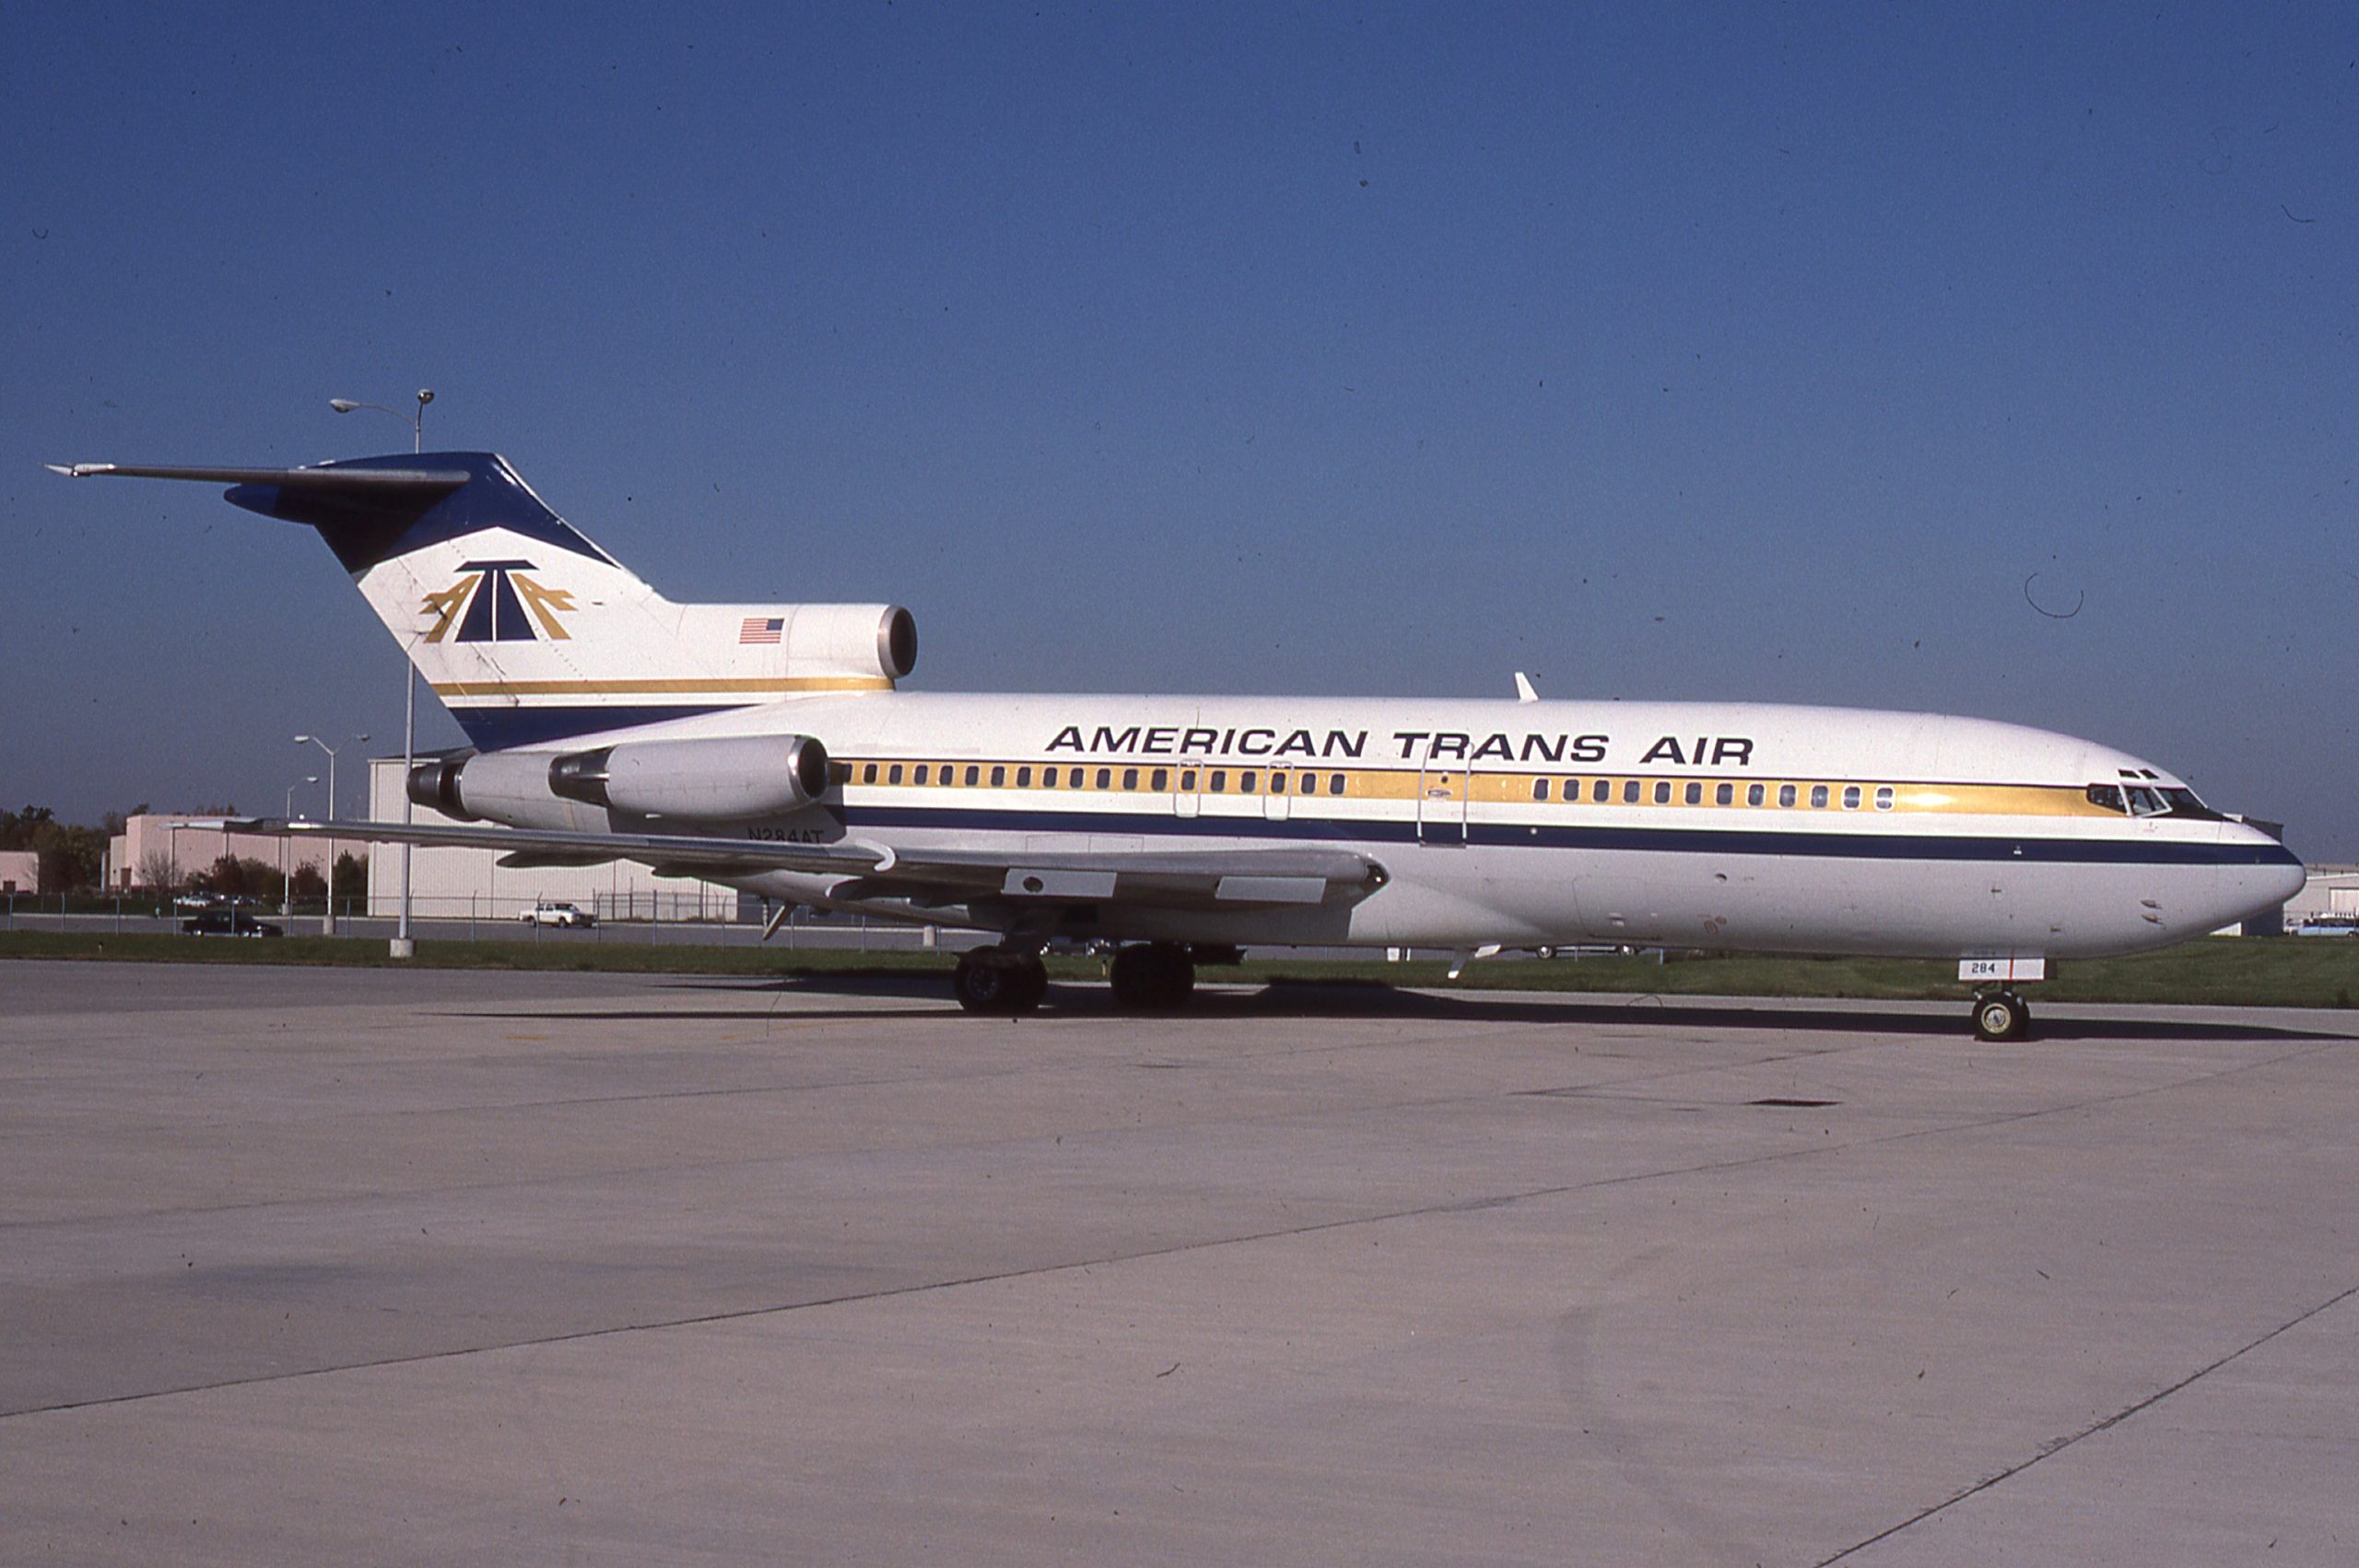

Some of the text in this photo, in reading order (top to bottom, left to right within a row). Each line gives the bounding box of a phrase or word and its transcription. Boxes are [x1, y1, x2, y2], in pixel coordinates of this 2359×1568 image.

[1045, 726, 1755, 766] AMERICAN TRANS AIR
[747, 827, 825, 843] N284AT
[1971, 963, 1996, 974] 284
